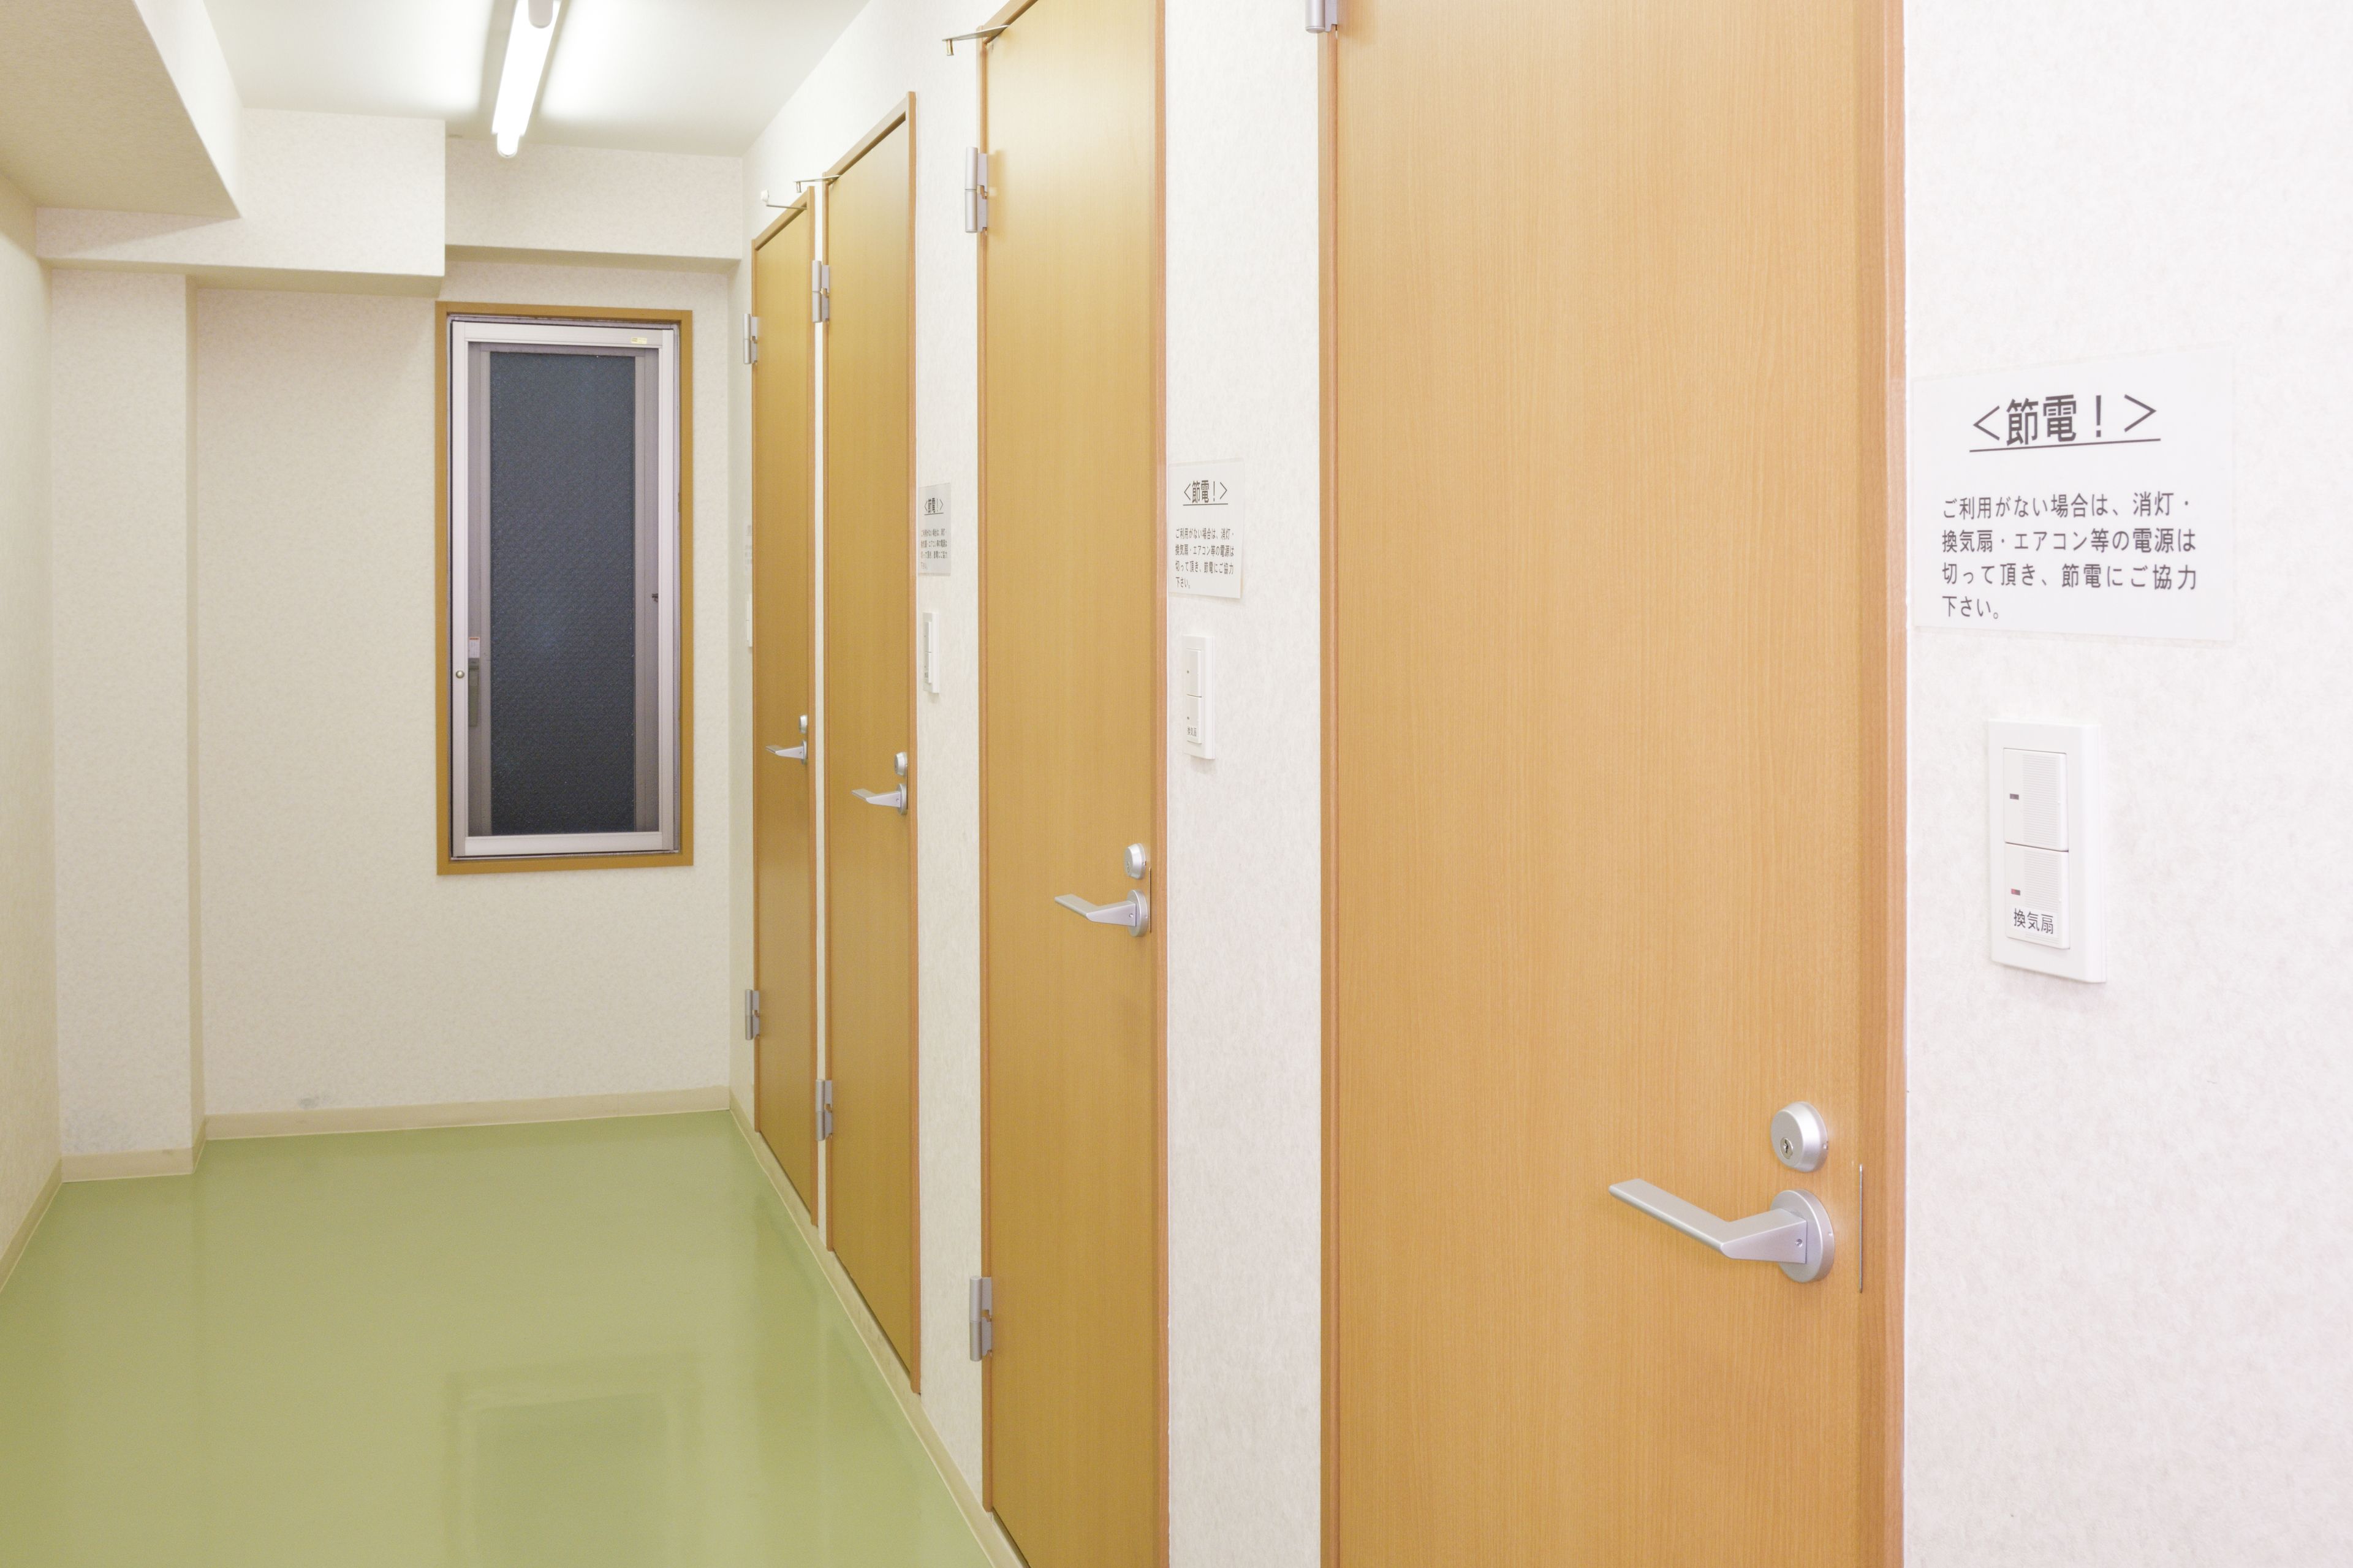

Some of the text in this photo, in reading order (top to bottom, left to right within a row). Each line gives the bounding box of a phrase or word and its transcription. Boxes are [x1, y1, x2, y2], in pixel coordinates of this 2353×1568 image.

[1942, 490, 2189, 520] ご利用がない場合は、消灯・
[1941, 527, 2197, 554] 換気扇・エアコン等の電源は
[1941, 562, 2197, 591] 切って頂き、節電にご協力
[1942, 595, 1999, 620] 下さい。
[2013, 907, 2054, 935] 換気扇
